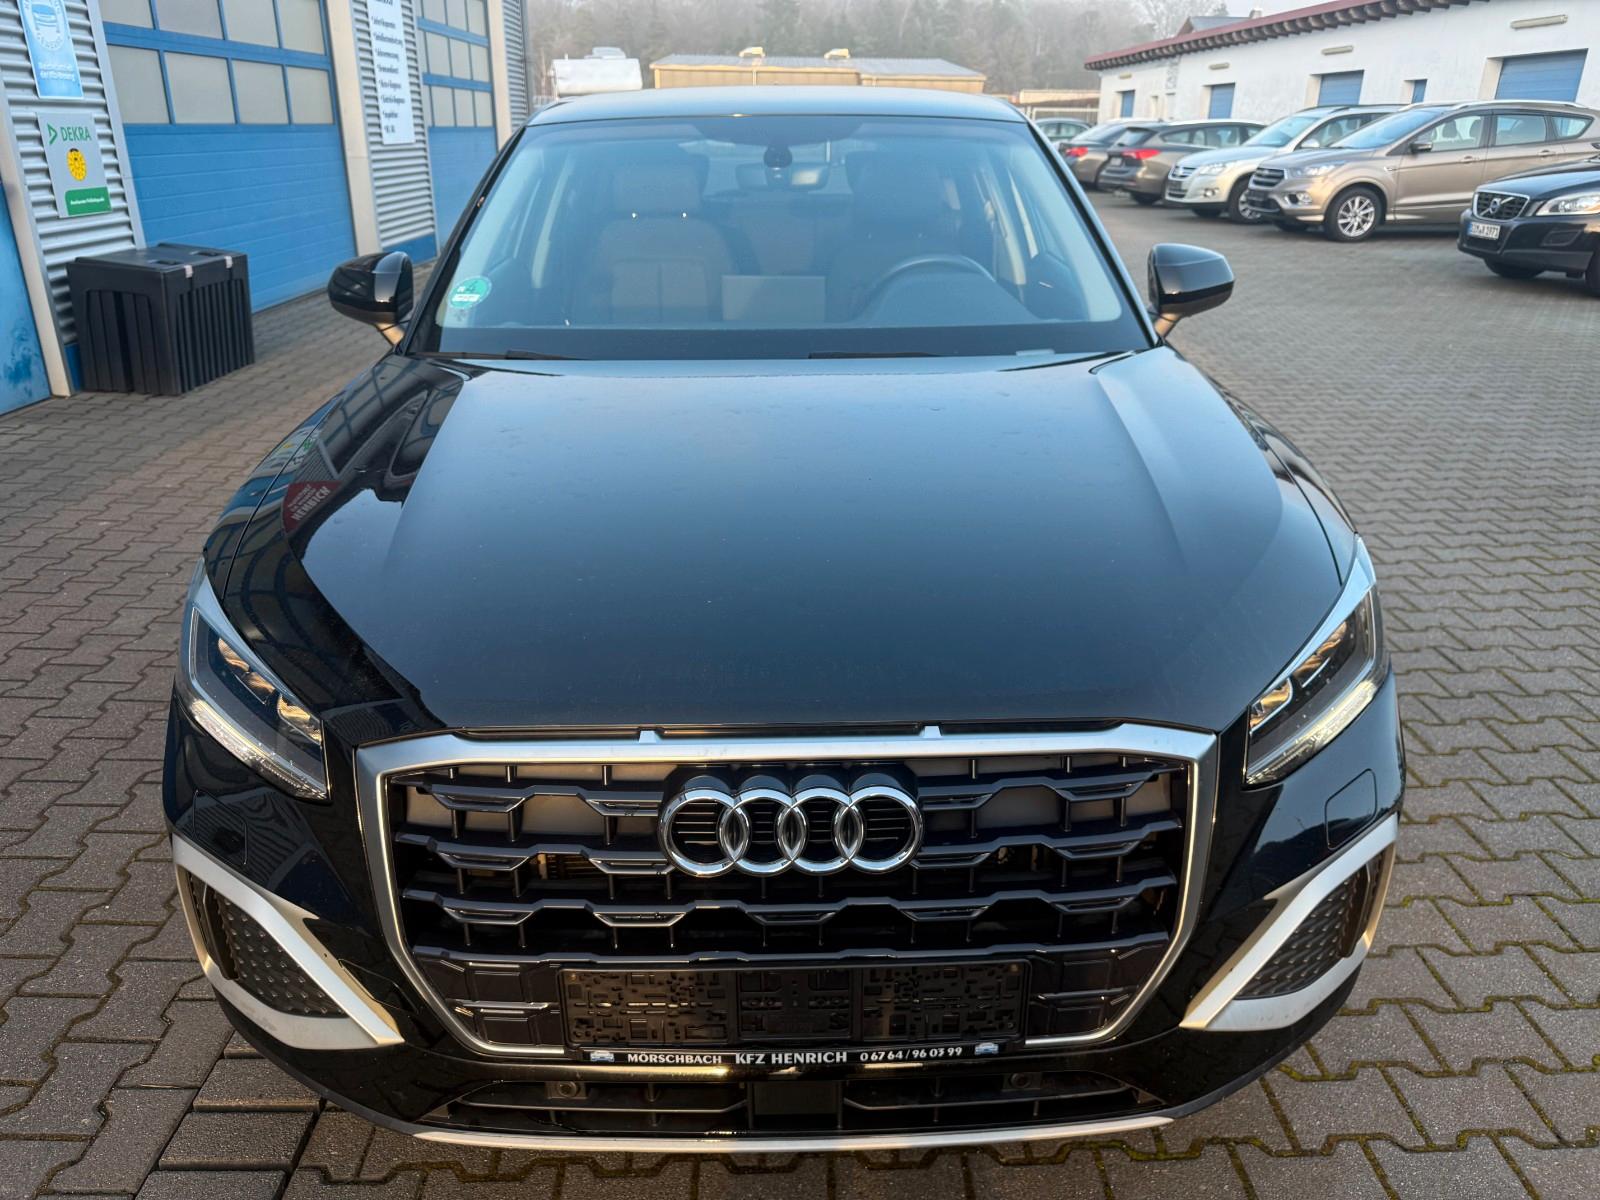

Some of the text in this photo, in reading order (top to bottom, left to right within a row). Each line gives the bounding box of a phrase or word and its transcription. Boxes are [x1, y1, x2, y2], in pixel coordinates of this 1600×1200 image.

[60, 126, 92, 141] DEKRA
[627, 1051, 722, 1064] MÖRSCHBACH
[735, 1052, 766, 1064] KFZ
[771, 1051, 847, 1064] HENRICH
